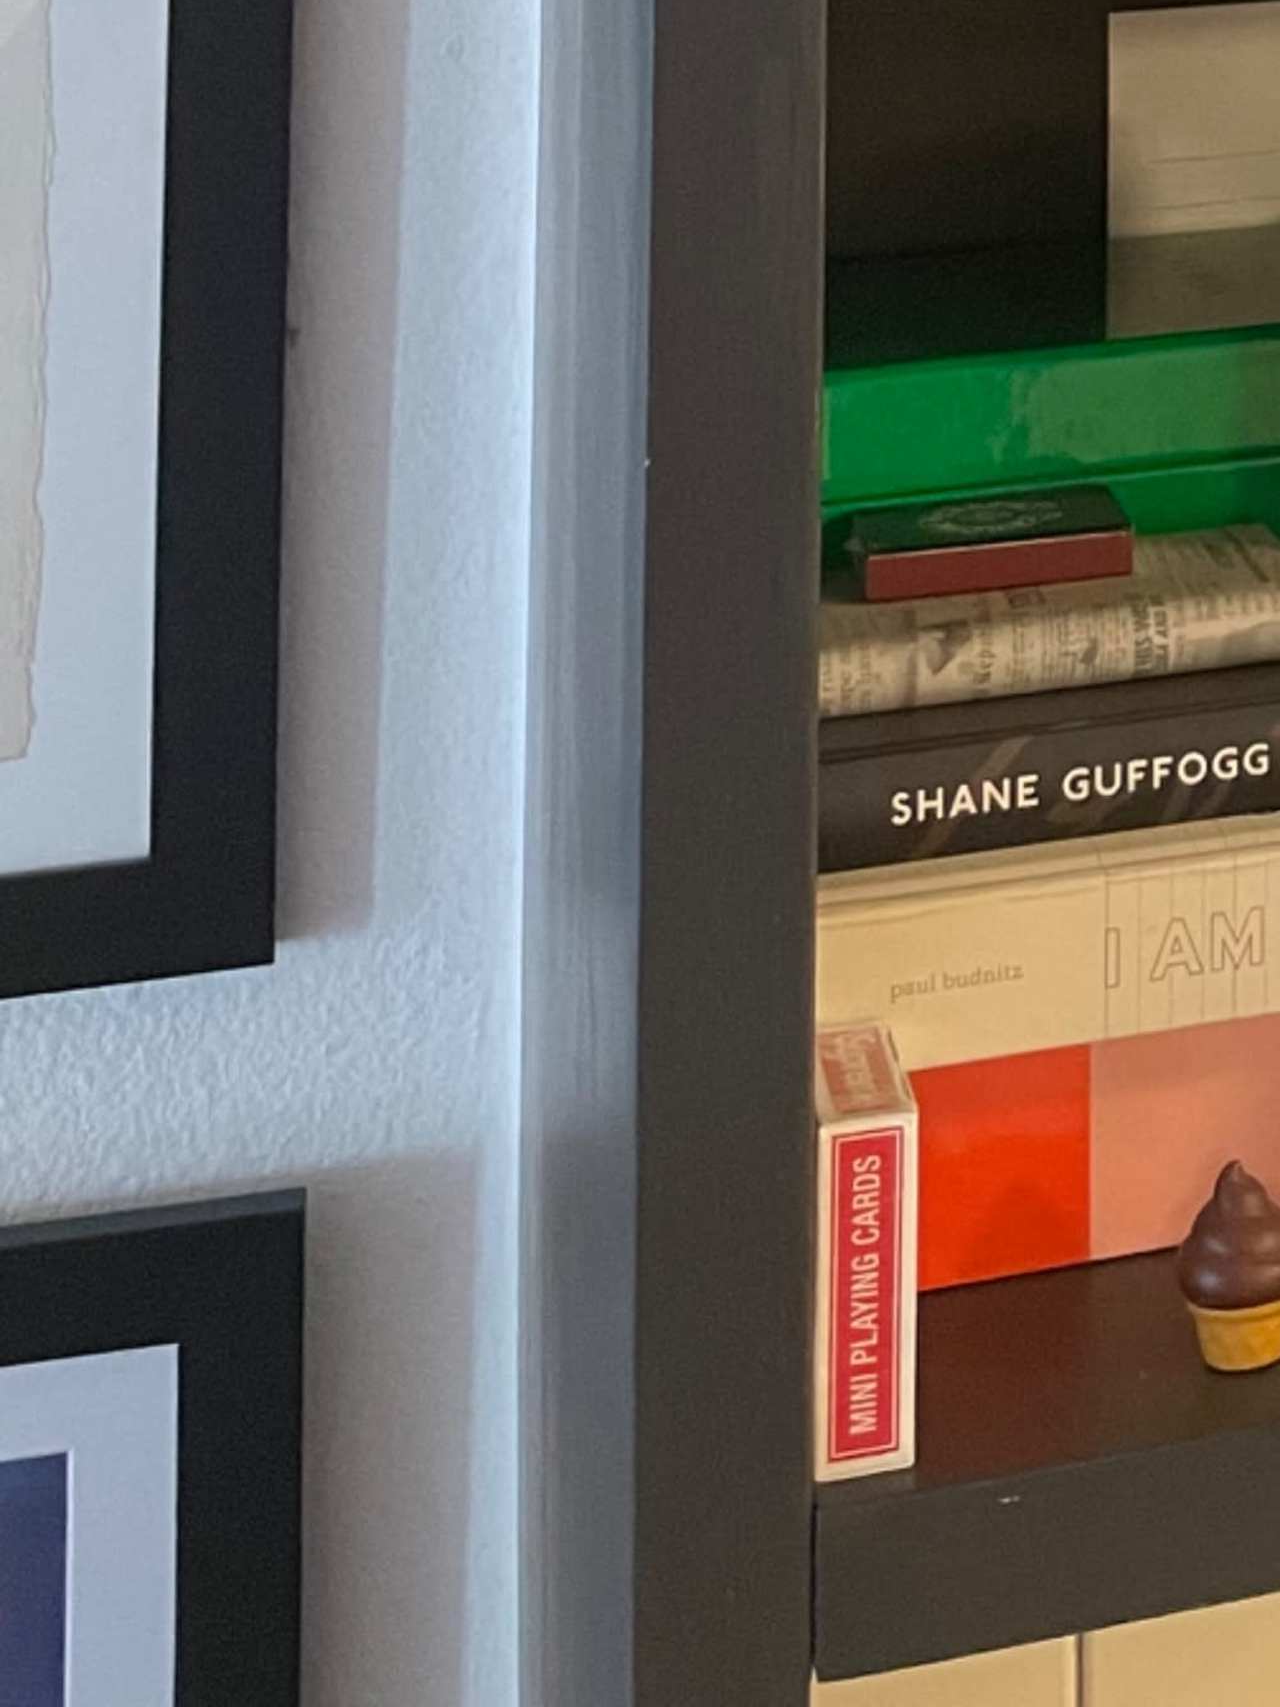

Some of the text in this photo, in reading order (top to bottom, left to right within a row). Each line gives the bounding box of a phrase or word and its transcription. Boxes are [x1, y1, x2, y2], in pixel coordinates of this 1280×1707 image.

[891, 774, 1039, 826] SHANE
[1062, 743, 1270, 801] GUFFOGG
[890, 963, 1024, 1005] paul budnitz
[1105, 927, 1120, 988] I
[1150, 905, 1265, 982] AM
[850, 1154, 881, 1435] MINI PLAYING CARDS
